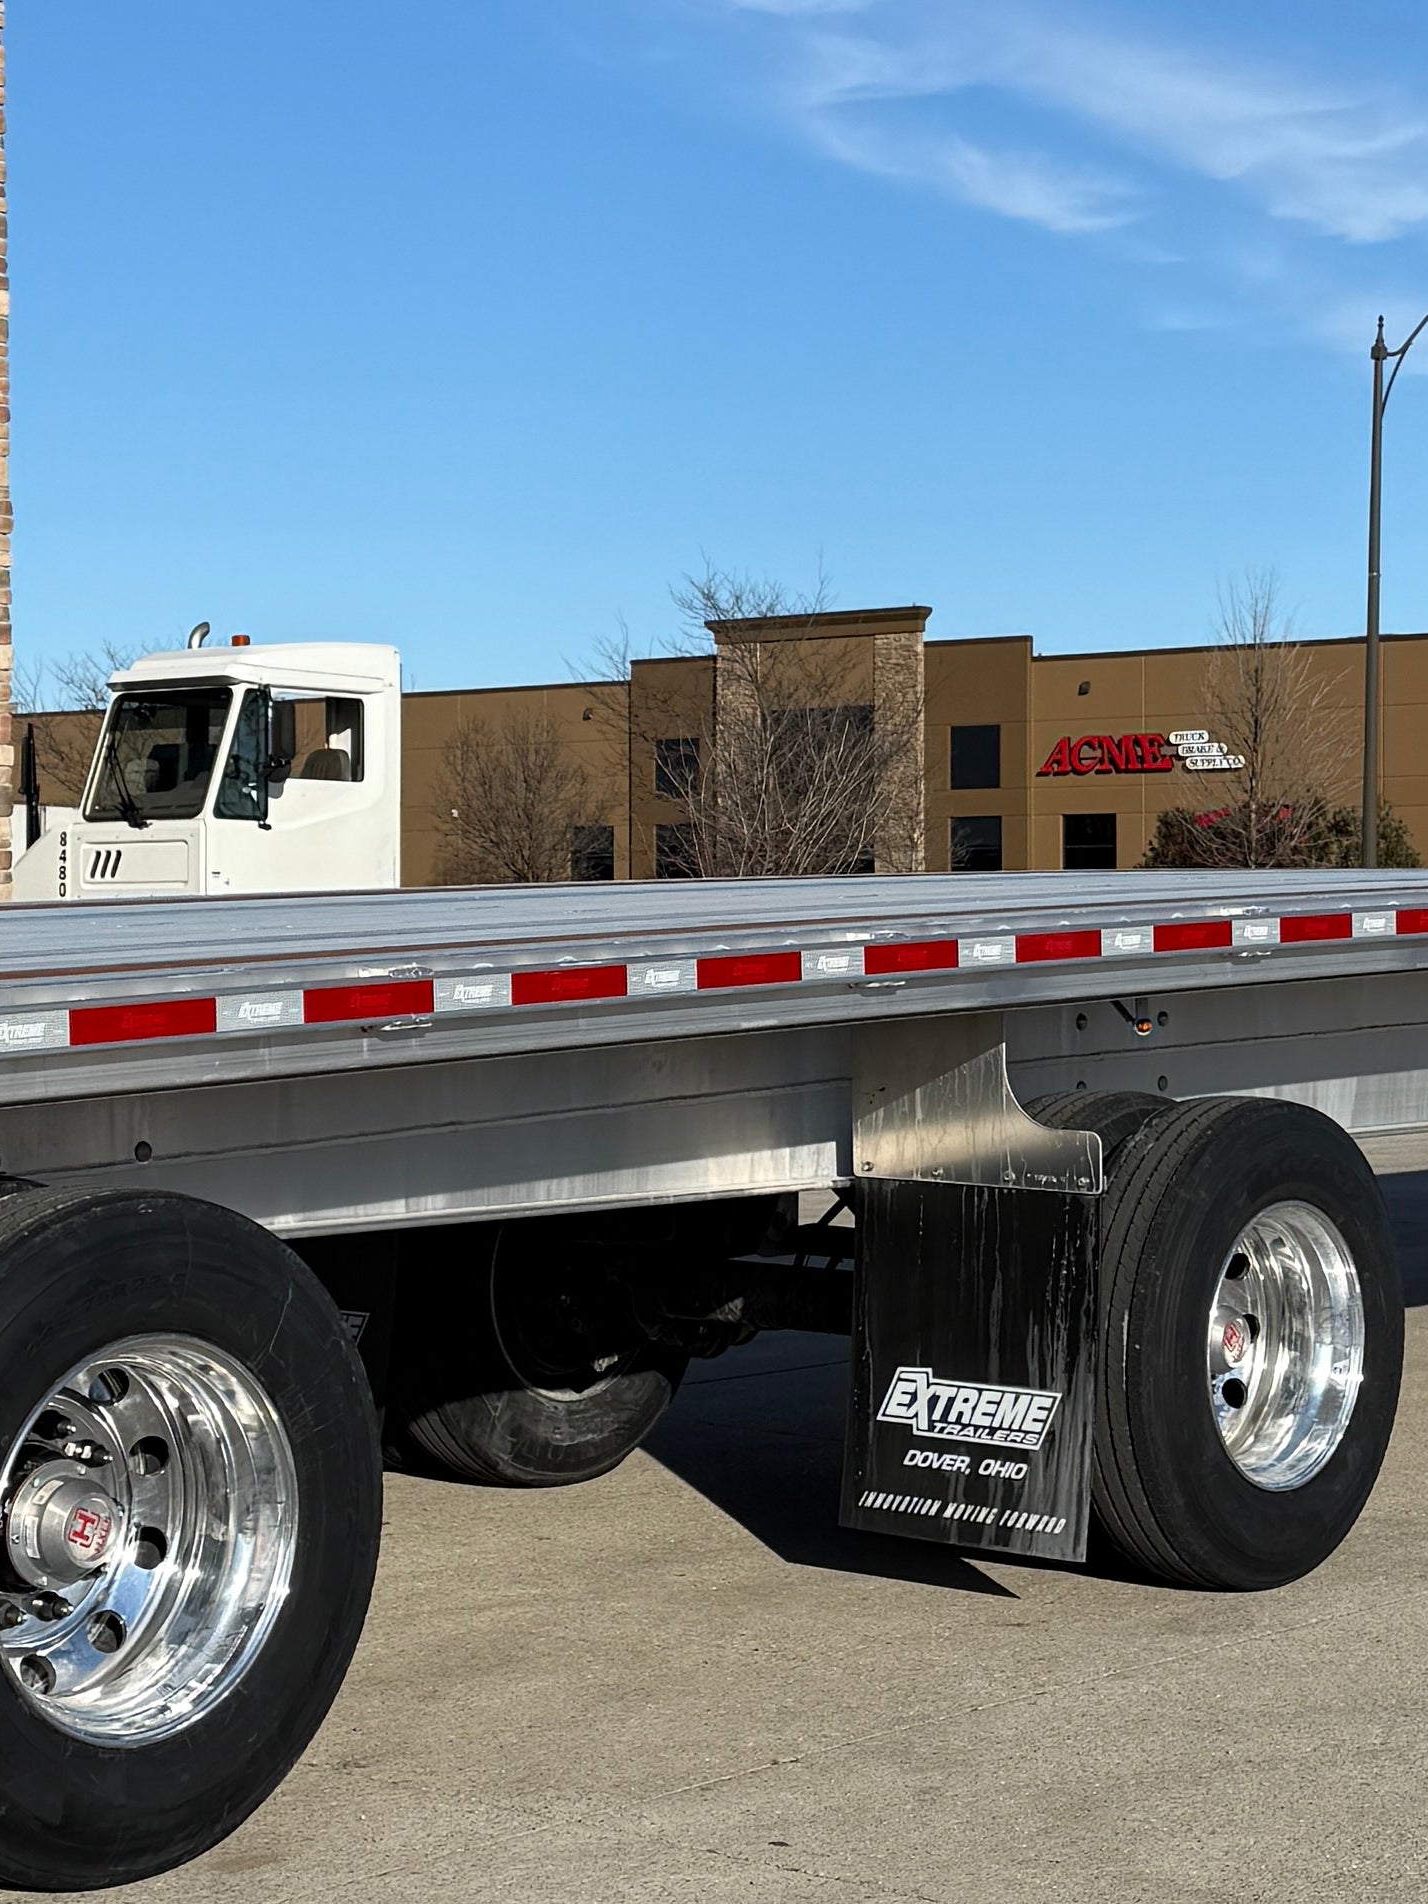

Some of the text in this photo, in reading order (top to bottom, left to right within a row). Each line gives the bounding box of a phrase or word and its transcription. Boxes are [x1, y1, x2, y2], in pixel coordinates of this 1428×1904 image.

[1036, 733, 1174, 776] ACME
[1173, 732, 1205, 742] TRUCK
[58, 831, 68, 897] 8480
[884, 1372, 1054, 1432] EXTREME
[933, 1421, 1040, 1445] TRAILERS
[903, 1449, 1029, 1480] DOVER, OHIO
[858, 1490, 1067, 1535] INNOVATION MOVING FORWARD
